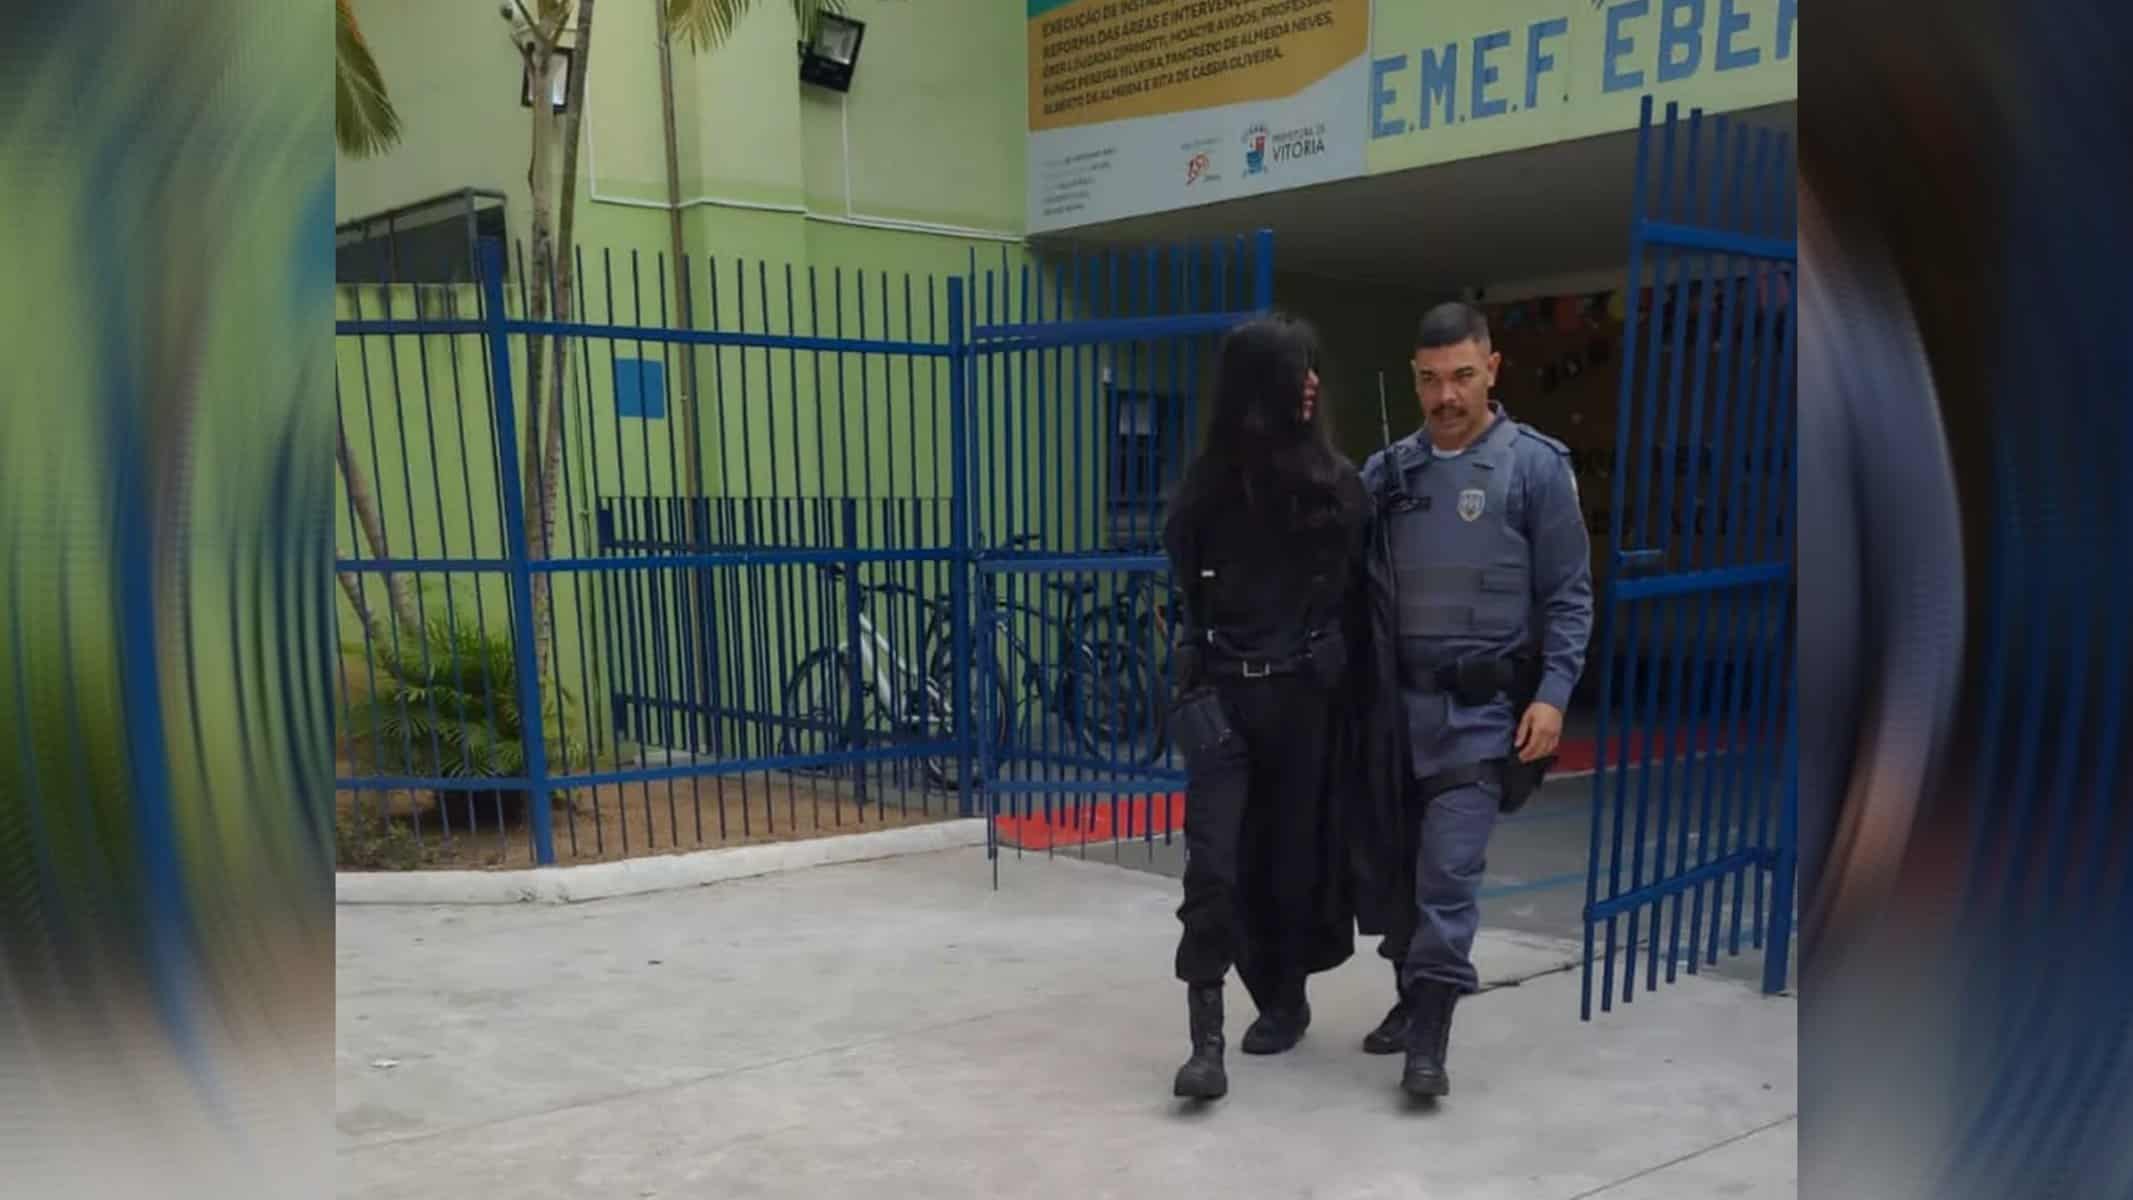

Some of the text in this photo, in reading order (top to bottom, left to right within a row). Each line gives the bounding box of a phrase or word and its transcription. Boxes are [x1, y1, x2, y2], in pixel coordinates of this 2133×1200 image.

[1042, 32, 1096, 58] REFORMA
[1098, 25, 1119, 43] DAS
[1223, 35, 1238, 50] DE
[1372, 17, 1569, 140] E.M.E.F.
